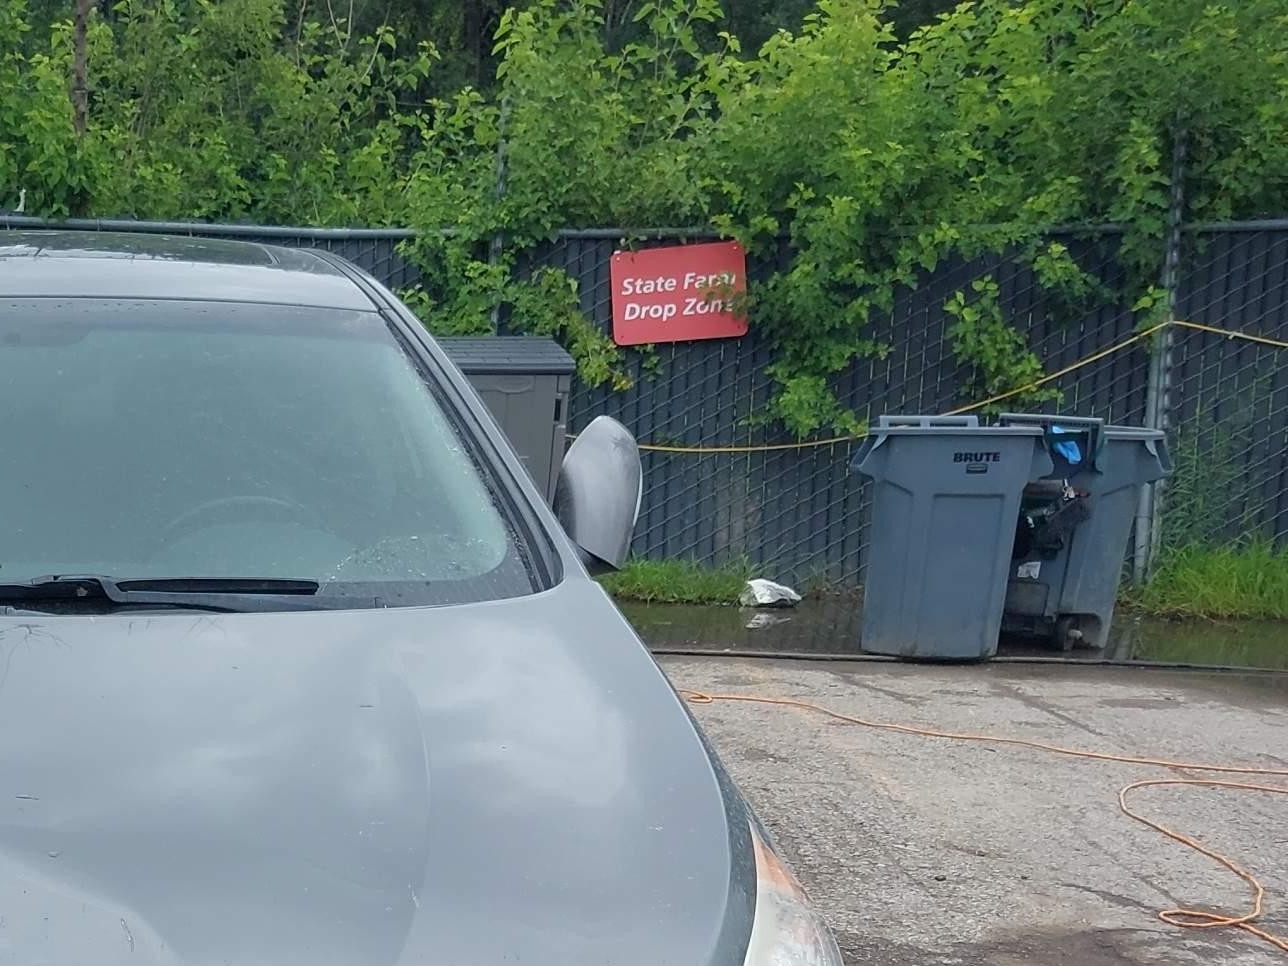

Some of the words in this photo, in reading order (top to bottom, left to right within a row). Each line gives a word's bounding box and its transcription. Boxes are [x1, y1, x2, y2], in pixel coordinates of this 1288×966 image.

[621, 276, 677, 296] State
[624, 303, 677, 322] Drop
[953, 452, 1000, 463] BRUTE
